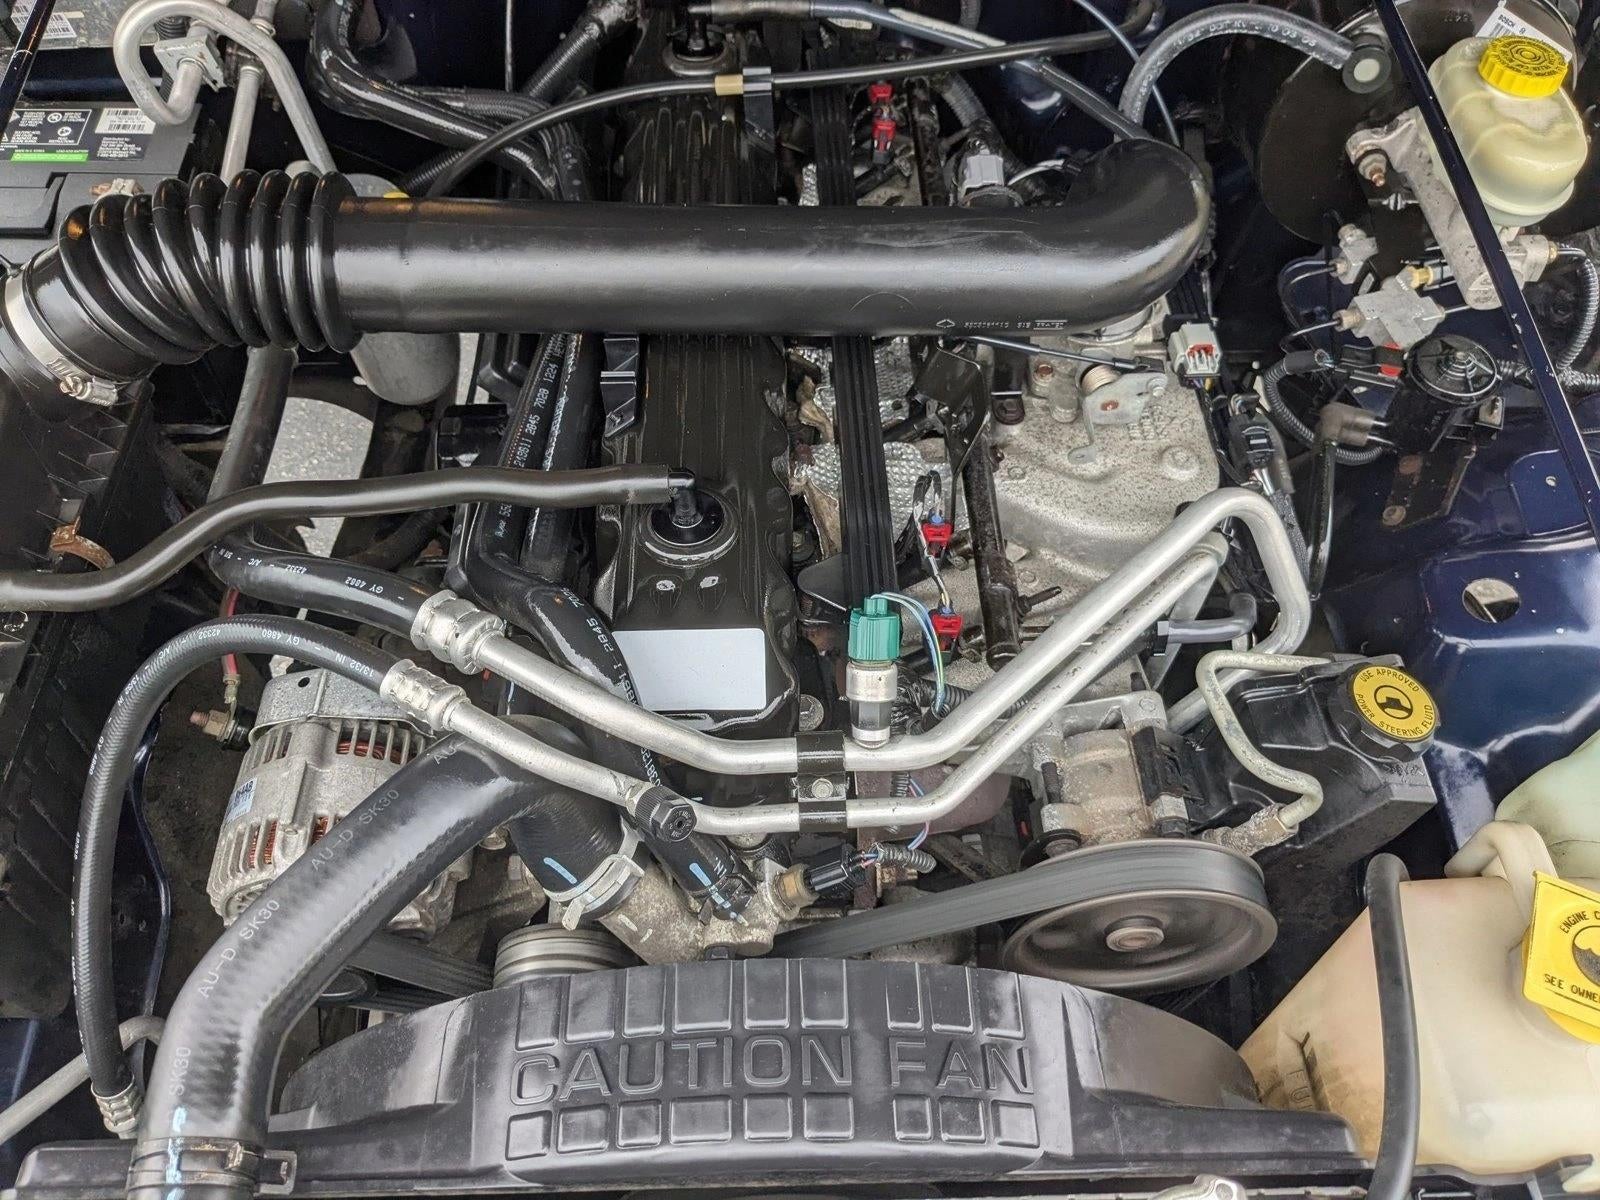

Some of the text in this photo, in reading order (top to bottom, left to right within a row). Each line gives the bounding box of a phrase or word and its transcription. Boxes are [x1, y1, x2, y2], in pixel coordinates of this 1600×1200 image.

[524, 414, 541, 436] 2845
[533, 387, 550, 409] 7028
[370, 585, 384, 594] GY
[261, 628, 282, 640] 4860
[286, 635, 300, 646] GY
[586, 617, 615, 653] 2845
[335, 653, 347, 664] IN
[350, 659, 375, 678] 13/32
[1360, 668, 1420, 692] USE APPROVED
[1355, 693, 1433, 736] POWER STEERING FLUID
[1559, 910, 1590, 935] ENGINE
[169, 1046, 192, 1097] SK30
[196, 947, 236, 1000] AU-D
[239, 899, 280, 942] SK30
[311, 828, 355, 872] AU-D
[358, 789, 400, 825] SK30
[1544, 973, 1600, 1004] SEE OWNE
[509, 1034, 1035, 1106] CAUTION FAN
